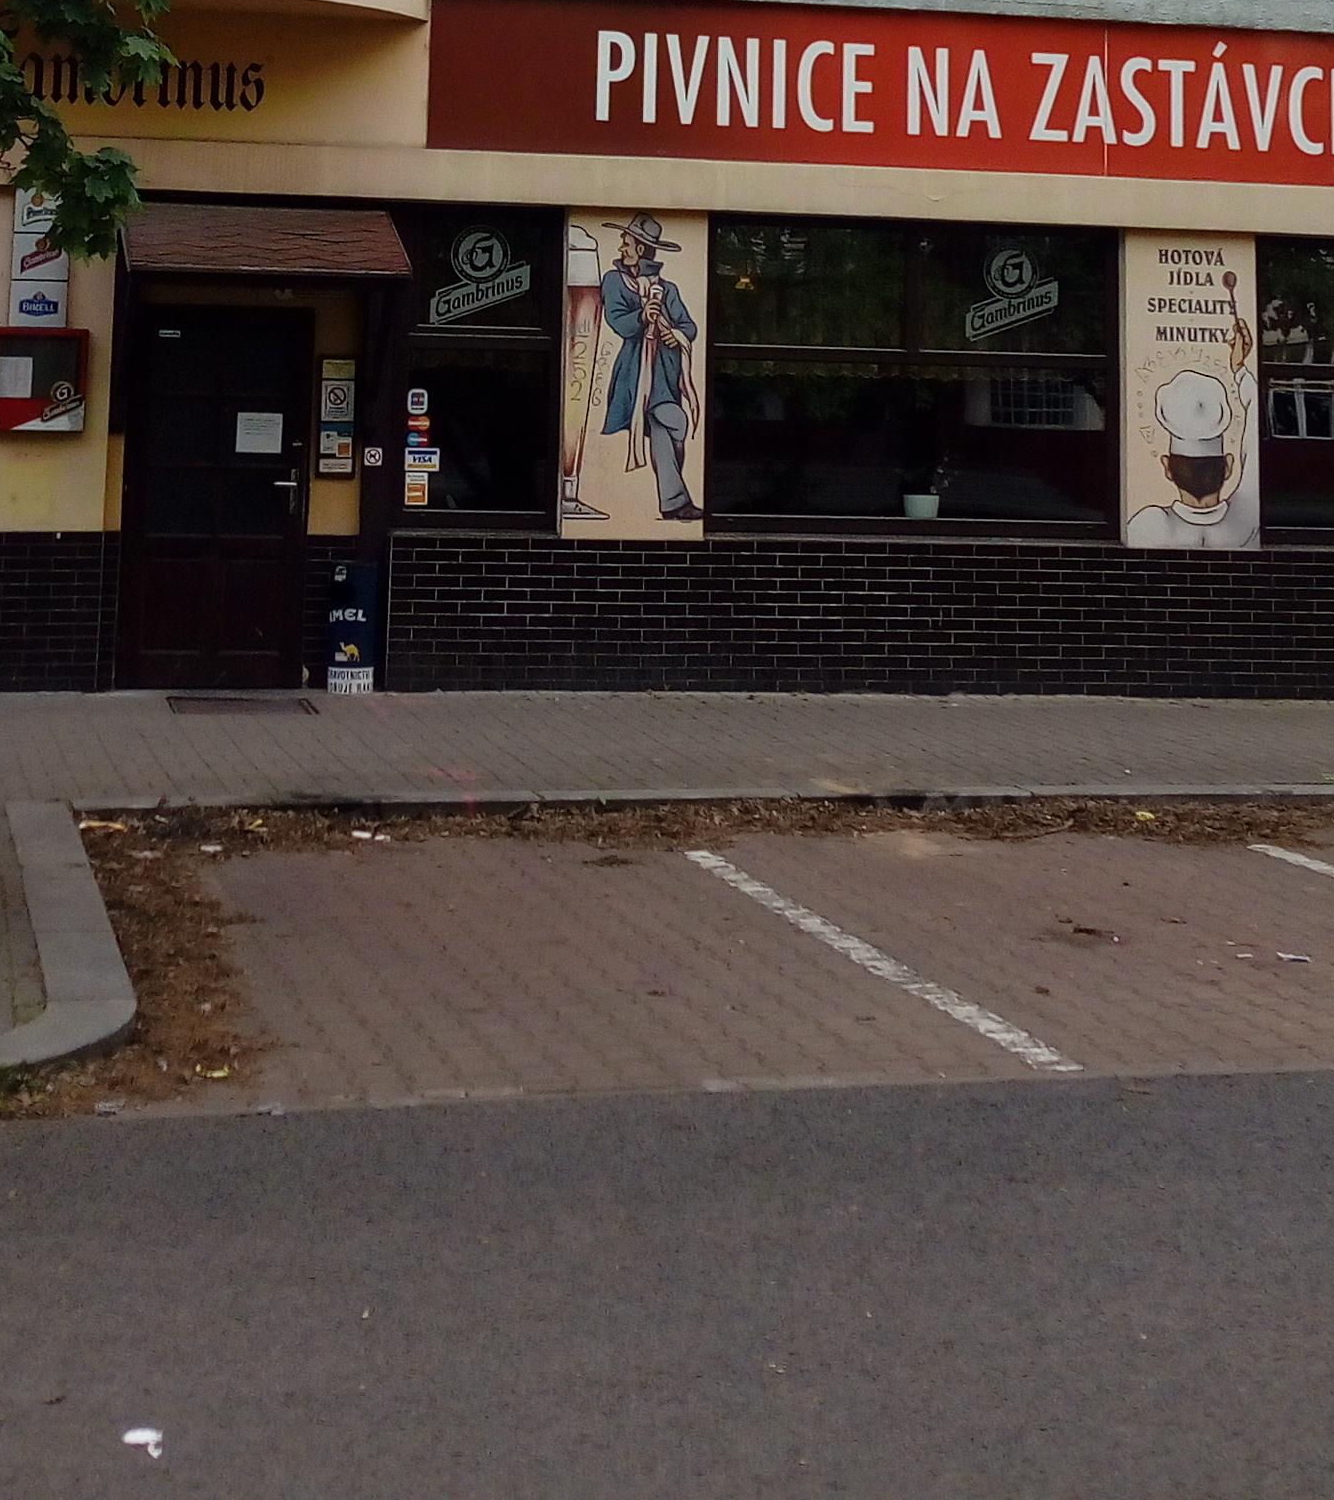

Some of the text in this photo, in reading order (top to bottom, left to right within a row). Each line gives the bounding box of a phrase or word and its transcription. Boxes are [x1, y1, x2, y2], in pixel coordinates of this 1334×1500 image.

[595, 30, 876, 134] PIVNICE
[906, 45, 1003, 140] NA
[1157, 247, 1225, 267] HOTOVÁ
[1167, 267, 1215, 287] JÍDLA
[434, 275, 524, 318] Gambrinus
[1147, 297, 1237, 316] SPECIALITY
[970, 292, 1053, 333] Gambrinus
[1155, 325, 1230, 344] MINUTKY
[412, 455, 433, 464] VISA
[329, 608, 367, 623] MEL
